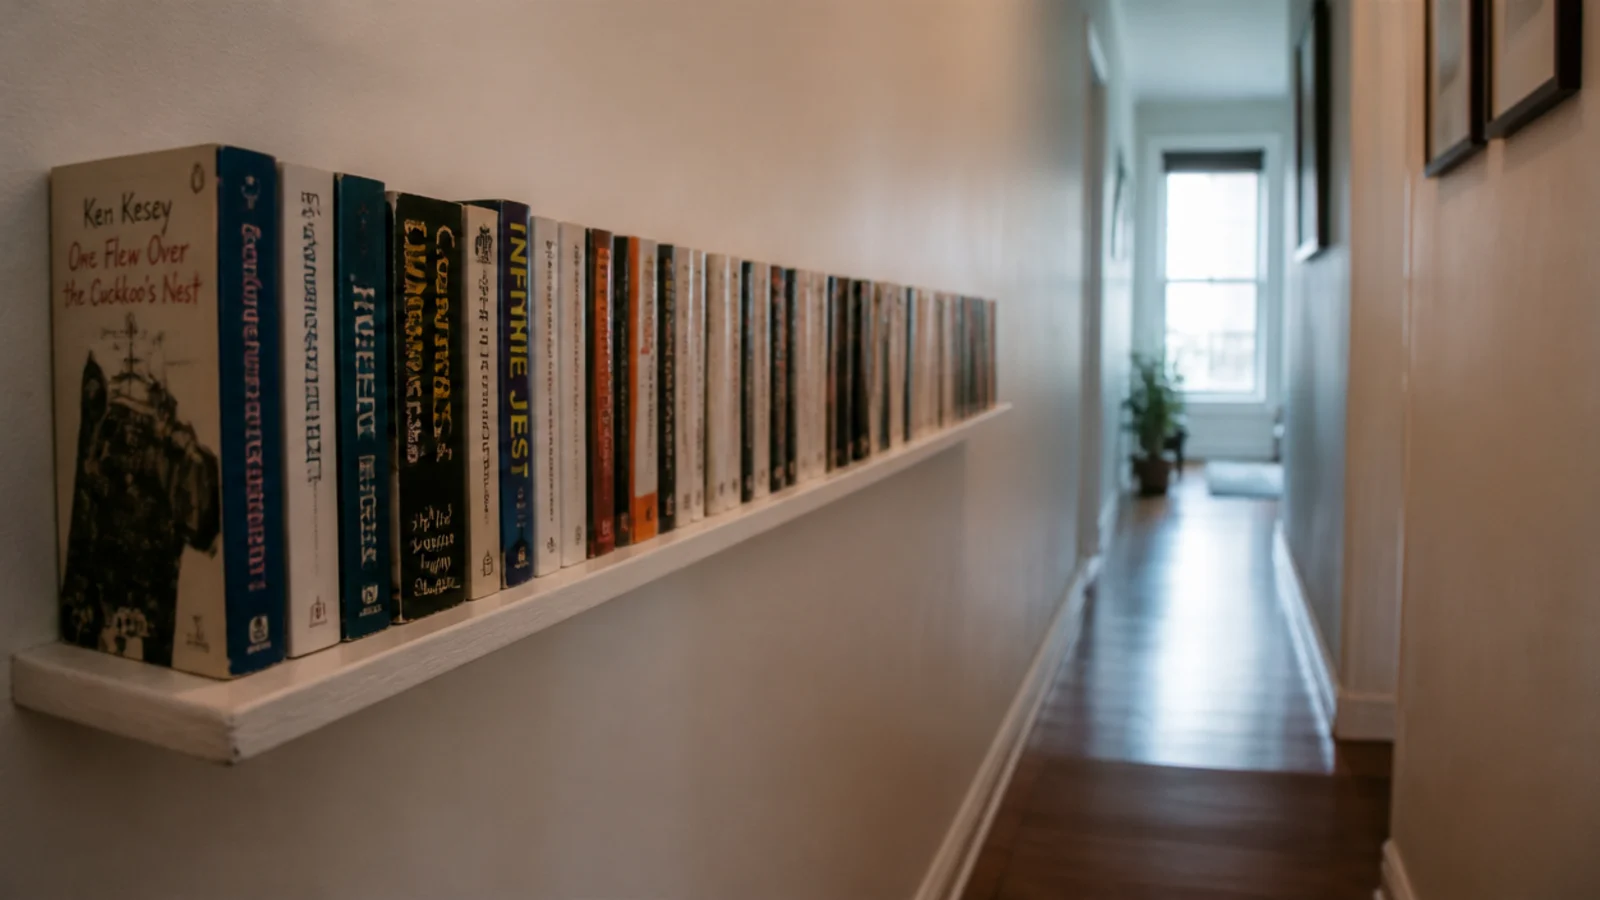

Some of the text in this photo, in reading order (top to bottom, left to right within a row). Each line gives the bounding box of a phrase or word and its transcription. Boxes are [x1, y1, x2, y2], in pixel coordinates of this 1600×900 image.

[83, 192, 172, 236] Ken Kesey
[68, 234, 190, 271] One Flew Over
[63, 279, 85, 308] the
[161, 270, 203, 305] Nest
[509, 390, 529, 478] JEST
